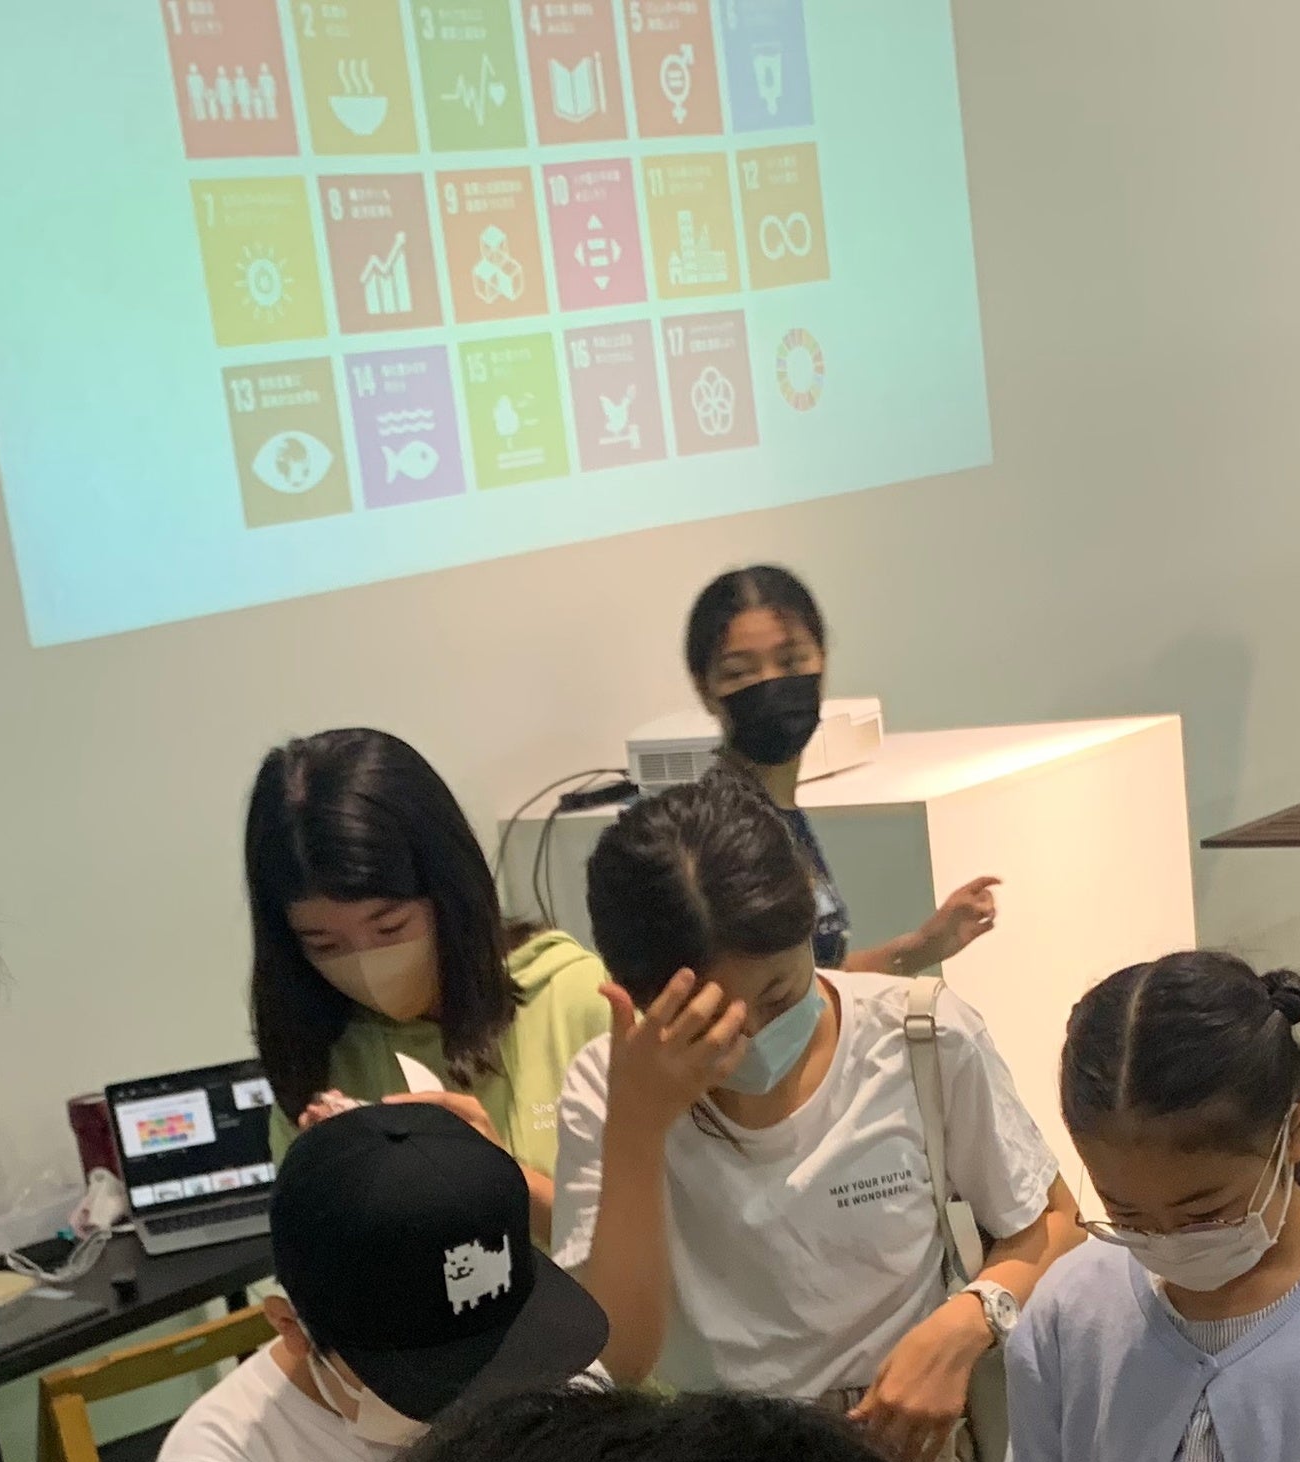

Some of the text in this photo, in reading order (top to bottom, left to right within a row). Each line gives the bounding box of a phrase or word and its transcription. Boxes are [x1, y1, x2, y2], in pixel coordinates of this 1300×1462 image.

[167, 1, 182, 36] 1
[301, 4, 316, 38] 2
[420, 6, 435, 40] 3
[529, 5, 542, 36] 4
[630, 0, 643, 33] 5
[443, 182, 460, 215] 9
[548, 174, 570, 206] 10
[649, 168, 666, 198] 11
[327, 187, 343, 221] 8
[569, 338, 591, 370] 16
[667, 327, 685, 357] 17
[352, 364, 376, 398] 14
[466, 352, 488, 383] 15
[230, 377, 256, 413] 13
[829, 1184, 849, 1196] MAY
[852, 1177, 879, 1191] YOUR
[837, 1184, 909, 1209] BE WONDERFUL
